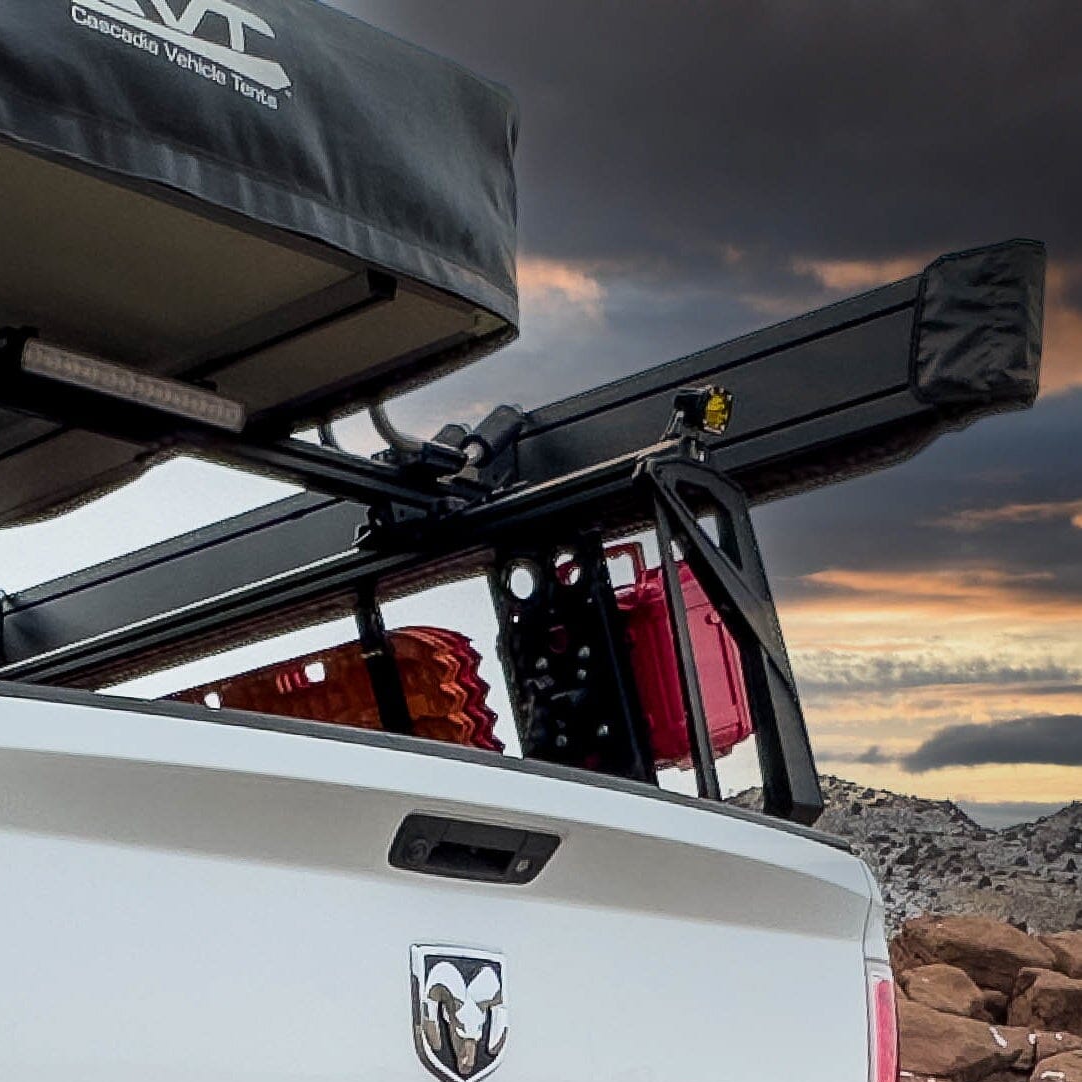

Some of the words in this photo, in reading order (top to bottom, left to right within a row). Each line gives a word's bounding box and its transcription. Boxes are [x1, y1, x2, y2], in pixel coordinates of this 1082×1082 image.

[71, 4, 159, 56] Cascadia
[164, 42, 227, 86] Vehicle
[231, 72, 279, 110] Tents
